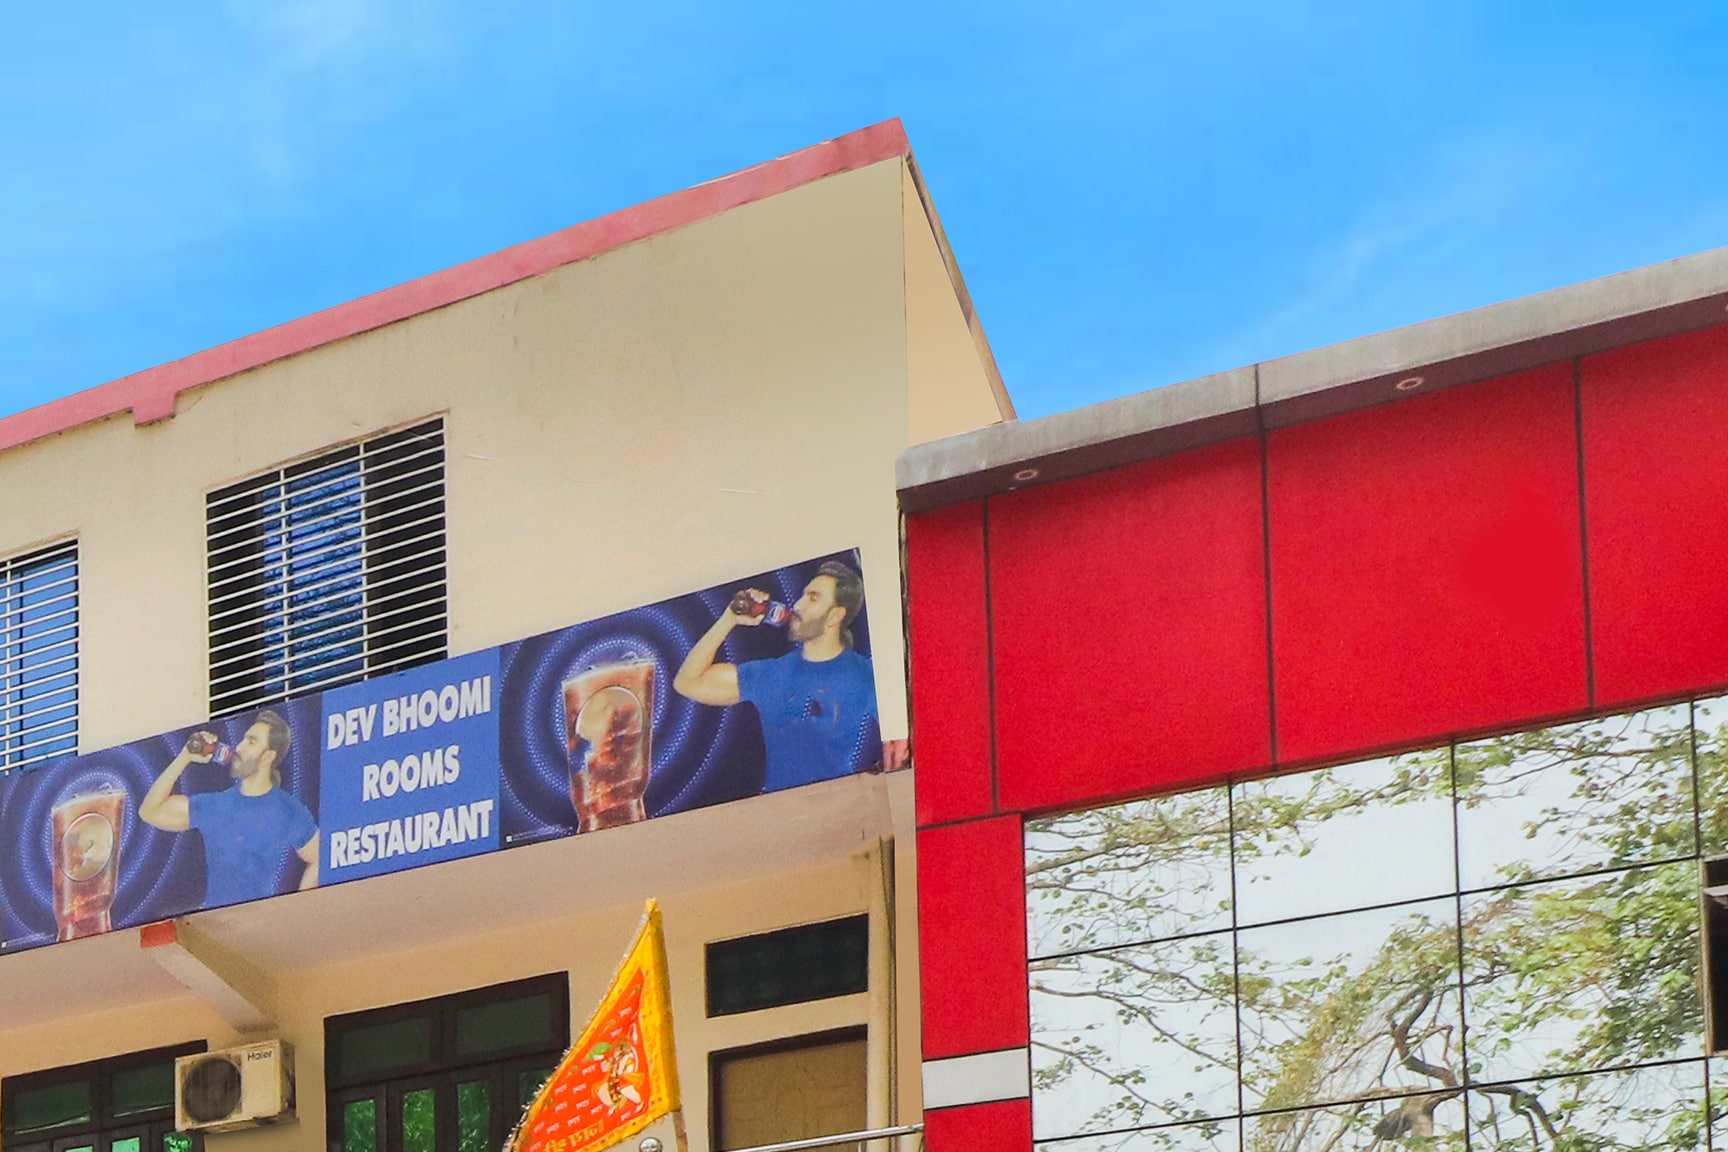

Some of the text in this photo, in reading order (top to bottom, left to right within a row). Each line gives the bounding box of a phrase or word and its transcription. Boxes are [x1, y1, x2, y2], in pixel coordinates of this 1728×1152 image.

[327, 675, 491, 750] DEV BHOOMI
[362, 744, 461, 802] ROOMS
[330, 799, 494, 869] RESTAURANT
[247, 1050, 274, 1062] Haier
